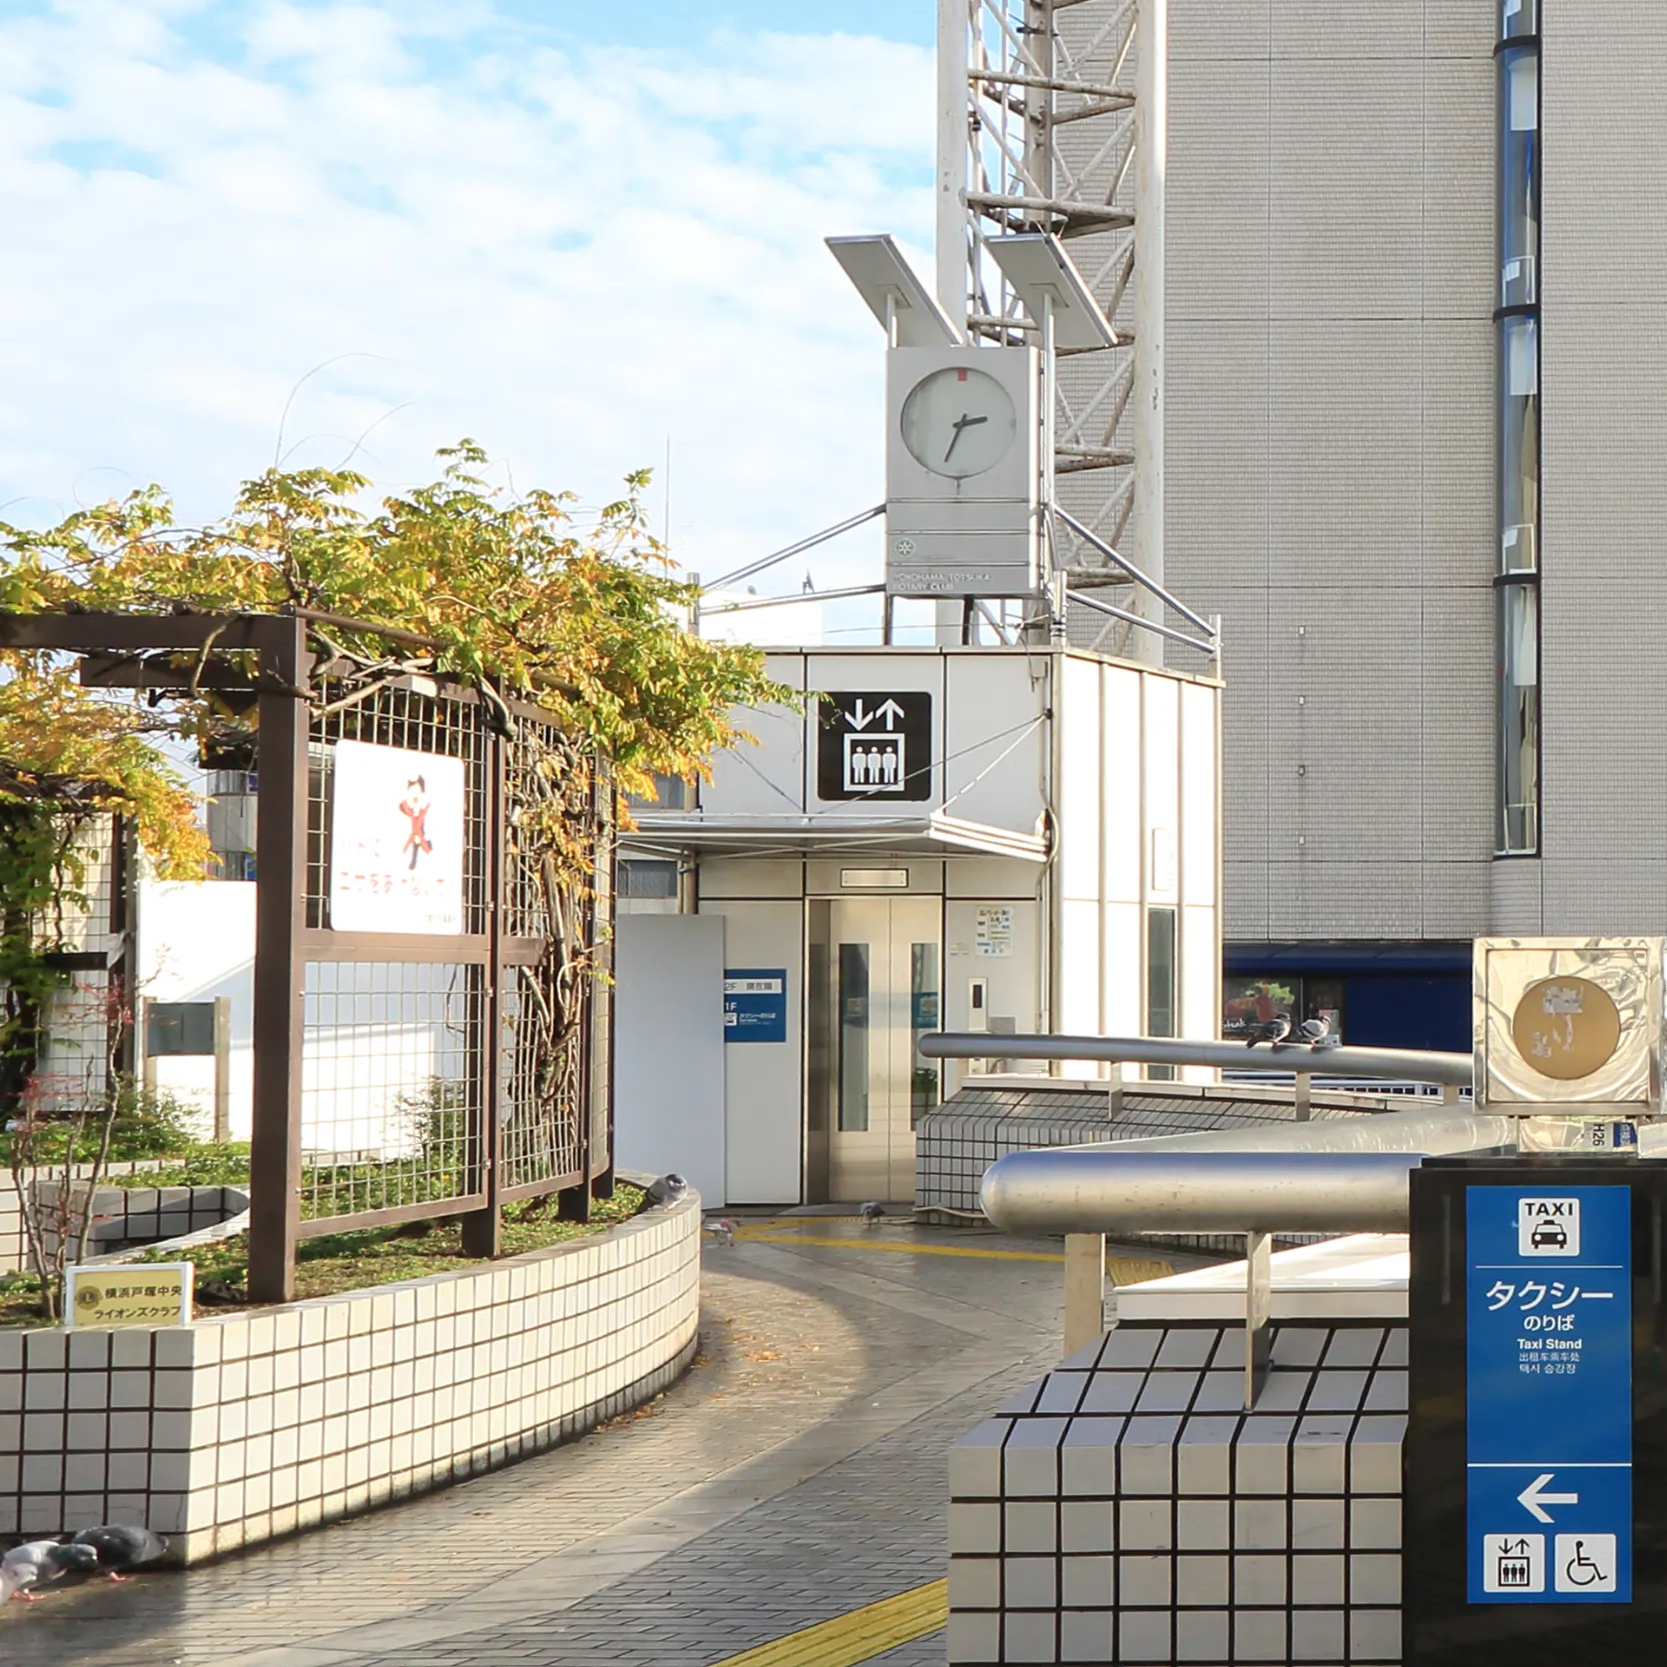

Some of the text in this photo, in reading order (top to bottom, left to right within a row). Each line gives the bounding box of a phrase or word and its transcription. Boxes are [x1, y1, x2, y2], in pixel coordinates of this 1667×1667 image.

[1592, 1123, 1605, 1146] H26
[1524, 1202, 1574, 1216] TAXI
[104, 1285, 183, 1300] 横浜戸塚中央
[1486, 1280, 1614, 1311] タクシー
[1523, 1313, 1576, 1331] のりば
[1516, 1338, 1583, 1350] Taxi Stand
[1519, 1363, 1577, 1375] 택시 승강장
